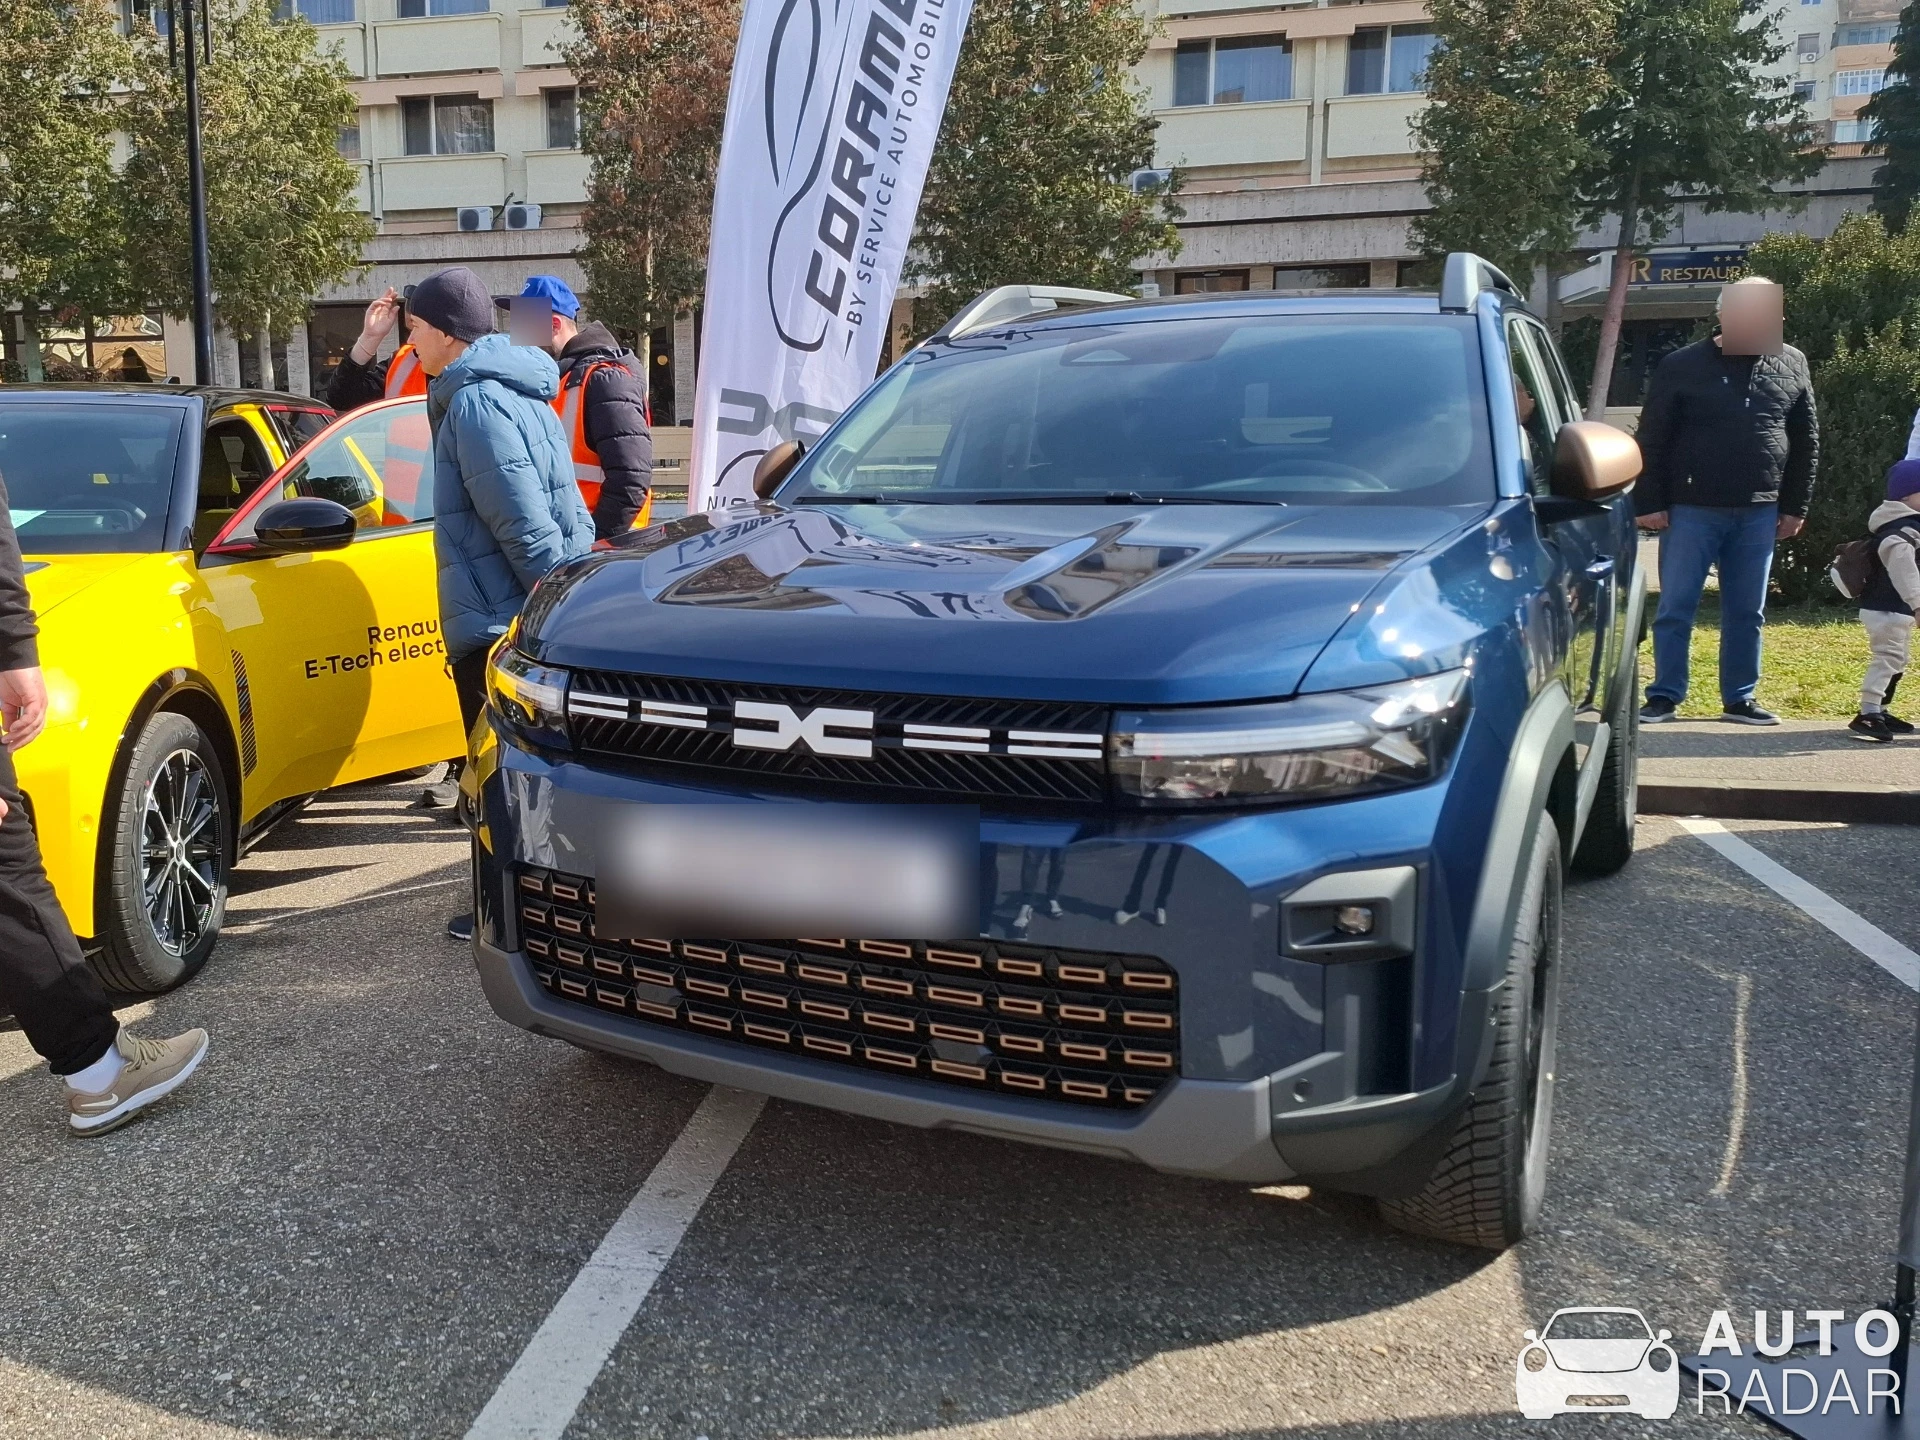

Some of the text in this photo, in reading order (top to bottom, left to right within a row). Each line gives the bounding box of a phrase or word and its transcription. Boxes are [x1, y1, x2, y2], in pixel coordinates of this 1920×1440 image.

[846, 292, 866, 326] BY
[857, 173, 897, 284] SERVICE
[367, 619, 438, 645] Renau
[304, 648, 383, 679] E-Tech
